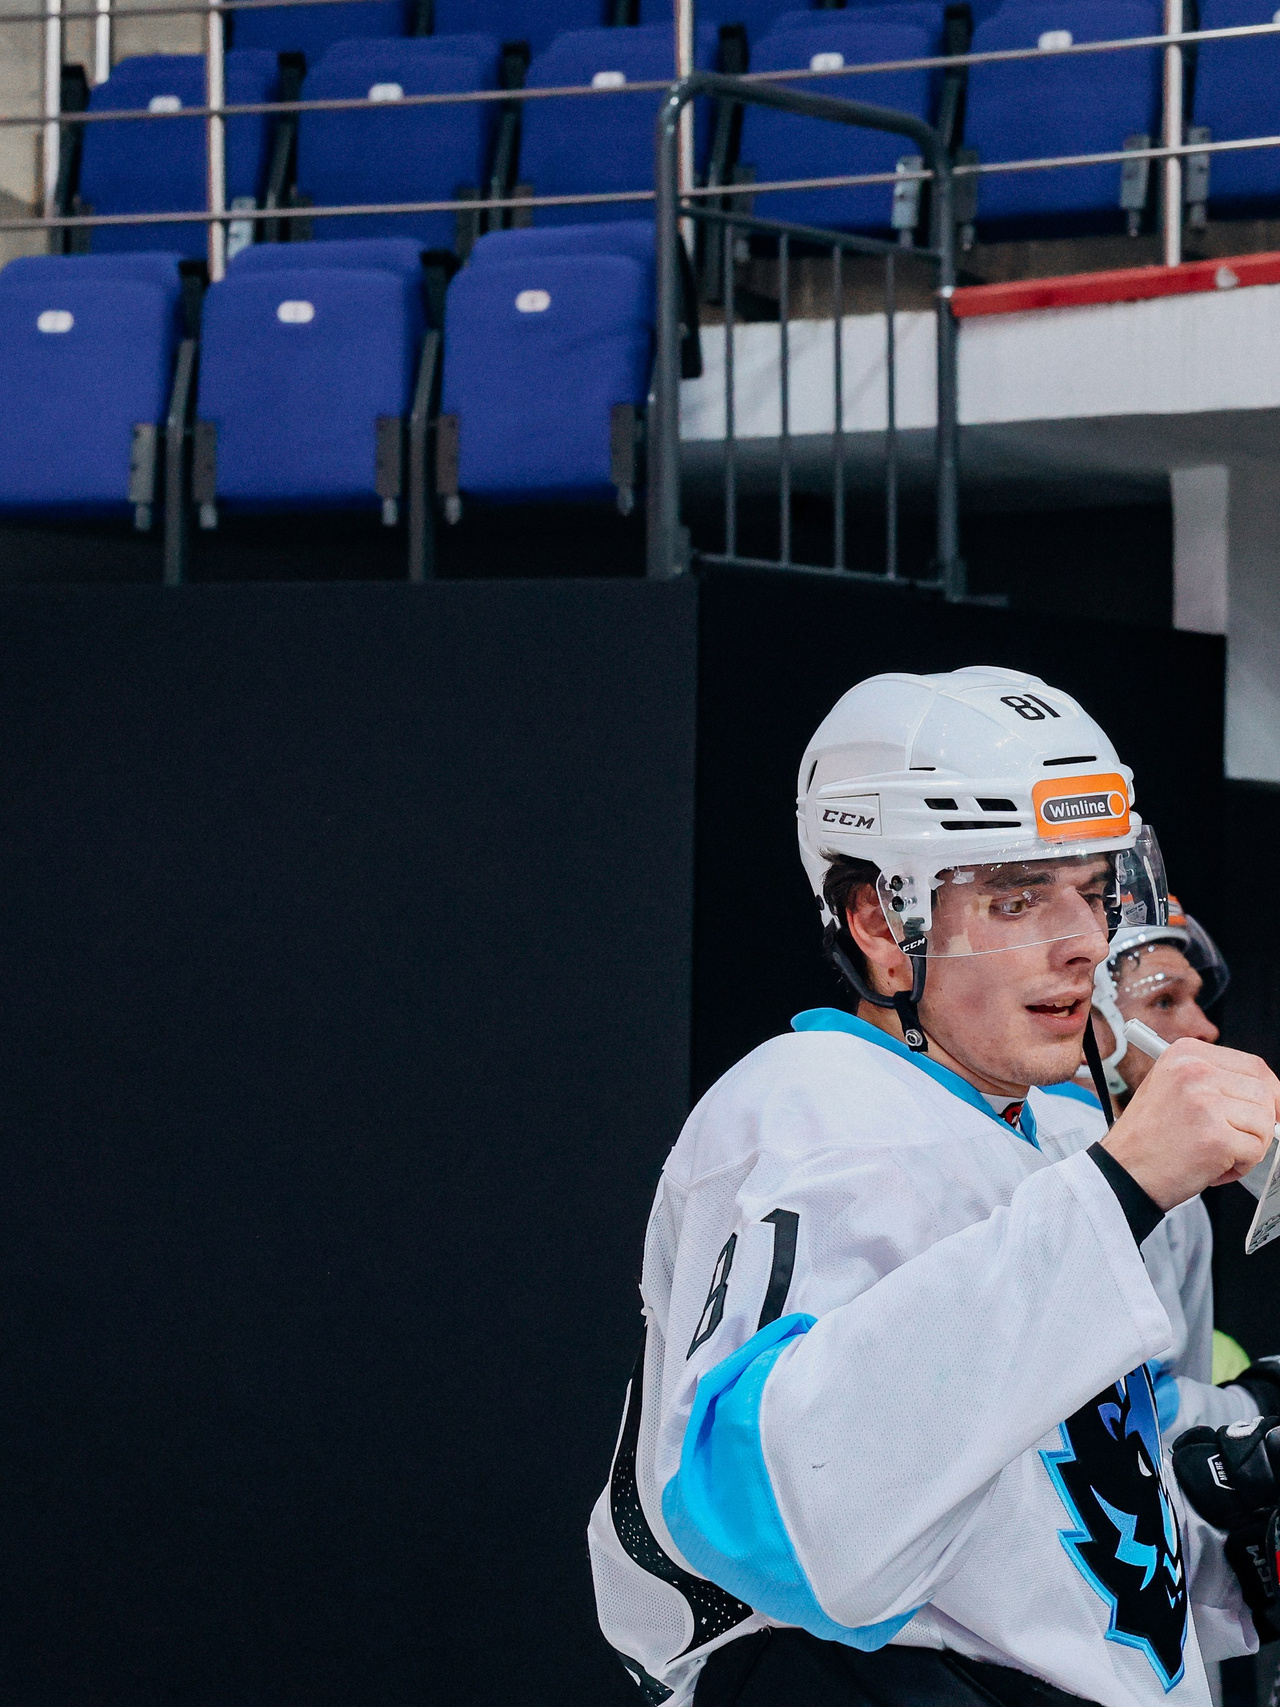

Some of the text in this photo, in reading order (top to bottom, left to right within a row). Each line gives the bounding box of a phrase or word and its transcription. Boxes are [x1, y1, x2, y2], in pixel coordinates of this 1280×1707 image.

[1000, 694, 1062, 720] 81
[822, 809, 876, 830] CCM
[1048, 800, 1105, 818] Winline
[902, 937, 926, 952] CCM
[686, 1208, 800, 1361] 81
